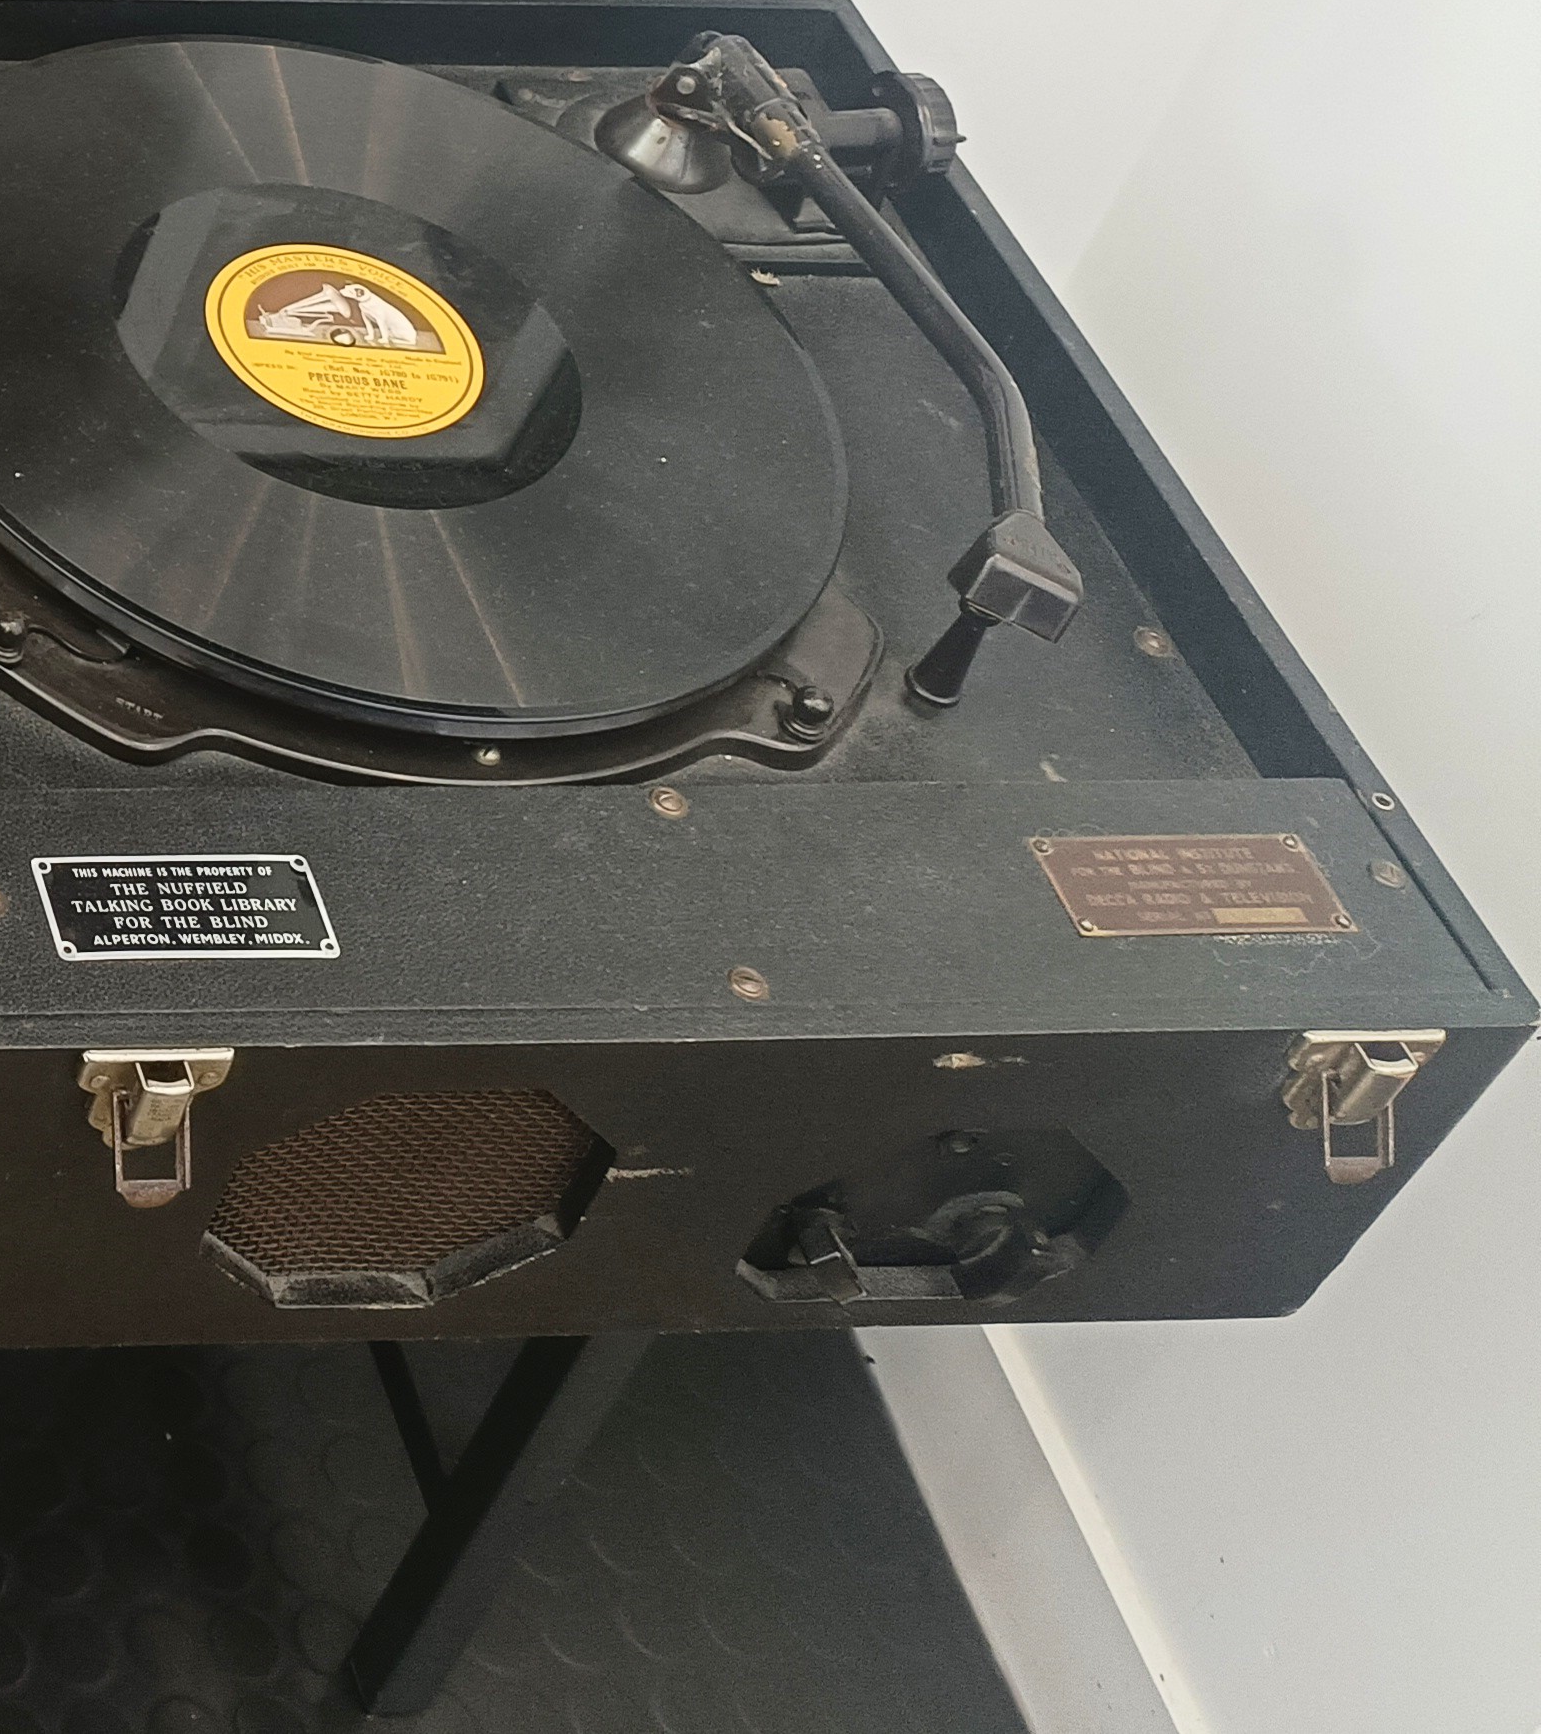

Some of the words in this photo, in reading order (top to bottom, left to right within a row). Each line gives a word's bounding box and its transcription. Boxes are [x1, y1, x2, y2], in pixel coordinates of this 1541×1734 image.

[308, 371, 370, 387] PRECIOUS
[373, 377, 409, 390] BANE
[71, 867, 97, 877] THIS
[101, 867, 152, 877] MACHINE
[156, 867, 167, 876] IS
[169, 866, 192, 876] THE
[196, 866, 252, 876] PROPERTY
[257, 866, 271, 875] OF
[109, 883, 148, 895] THE
[156, 881, 247, 894] NUFFIELD
[70, 899, 153, 912] TALKING
[160, 898, 214, 910] BOOK
[219, 898, 296, 911] LIBRARY
[113, 916, 152, 928] FOR
[160, 916, 200, 928] THE
[209, 915, 268, 928] BLIND
[254, 933, 310, 944] MIDDX.
